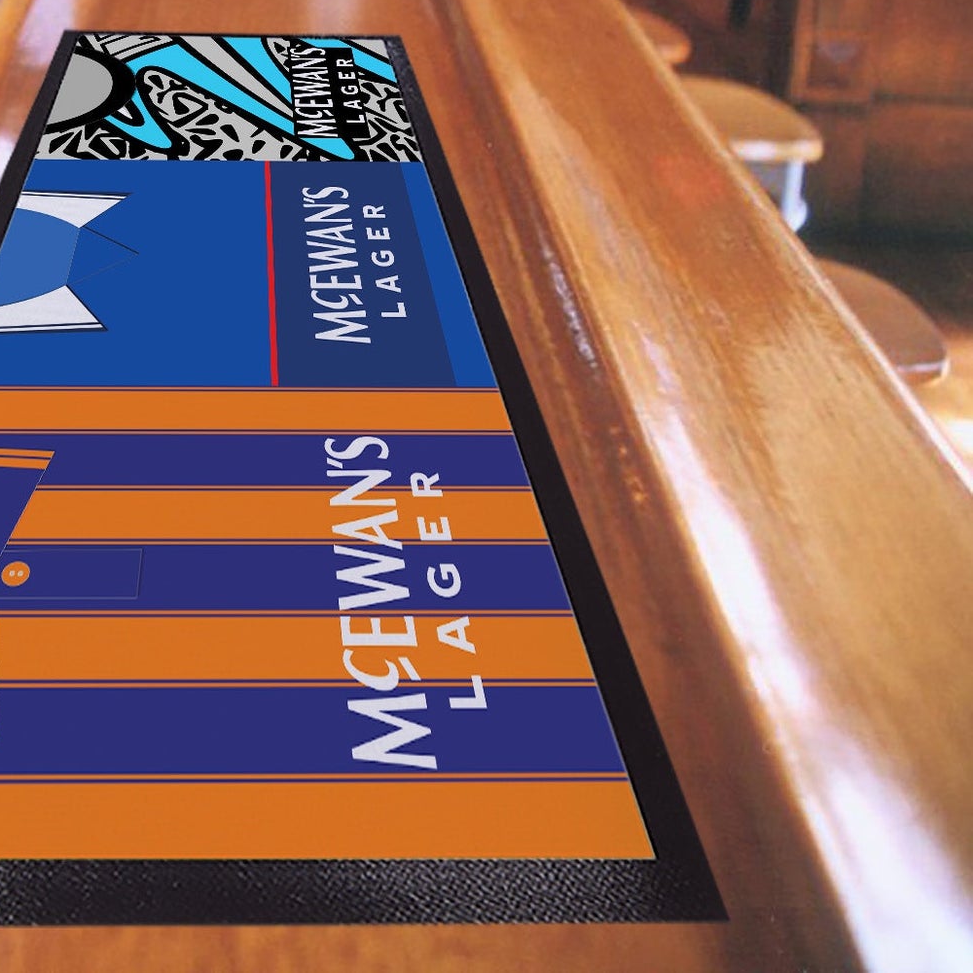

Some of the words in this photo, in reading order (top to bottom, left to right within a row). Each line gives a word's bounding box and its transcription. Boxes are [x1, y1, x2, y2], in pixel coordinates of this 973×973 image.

[336, 58, 366, 124] LAGER
[362, 203, 407, 318] LAGER
[410, 471, 488, 710] LAGER
